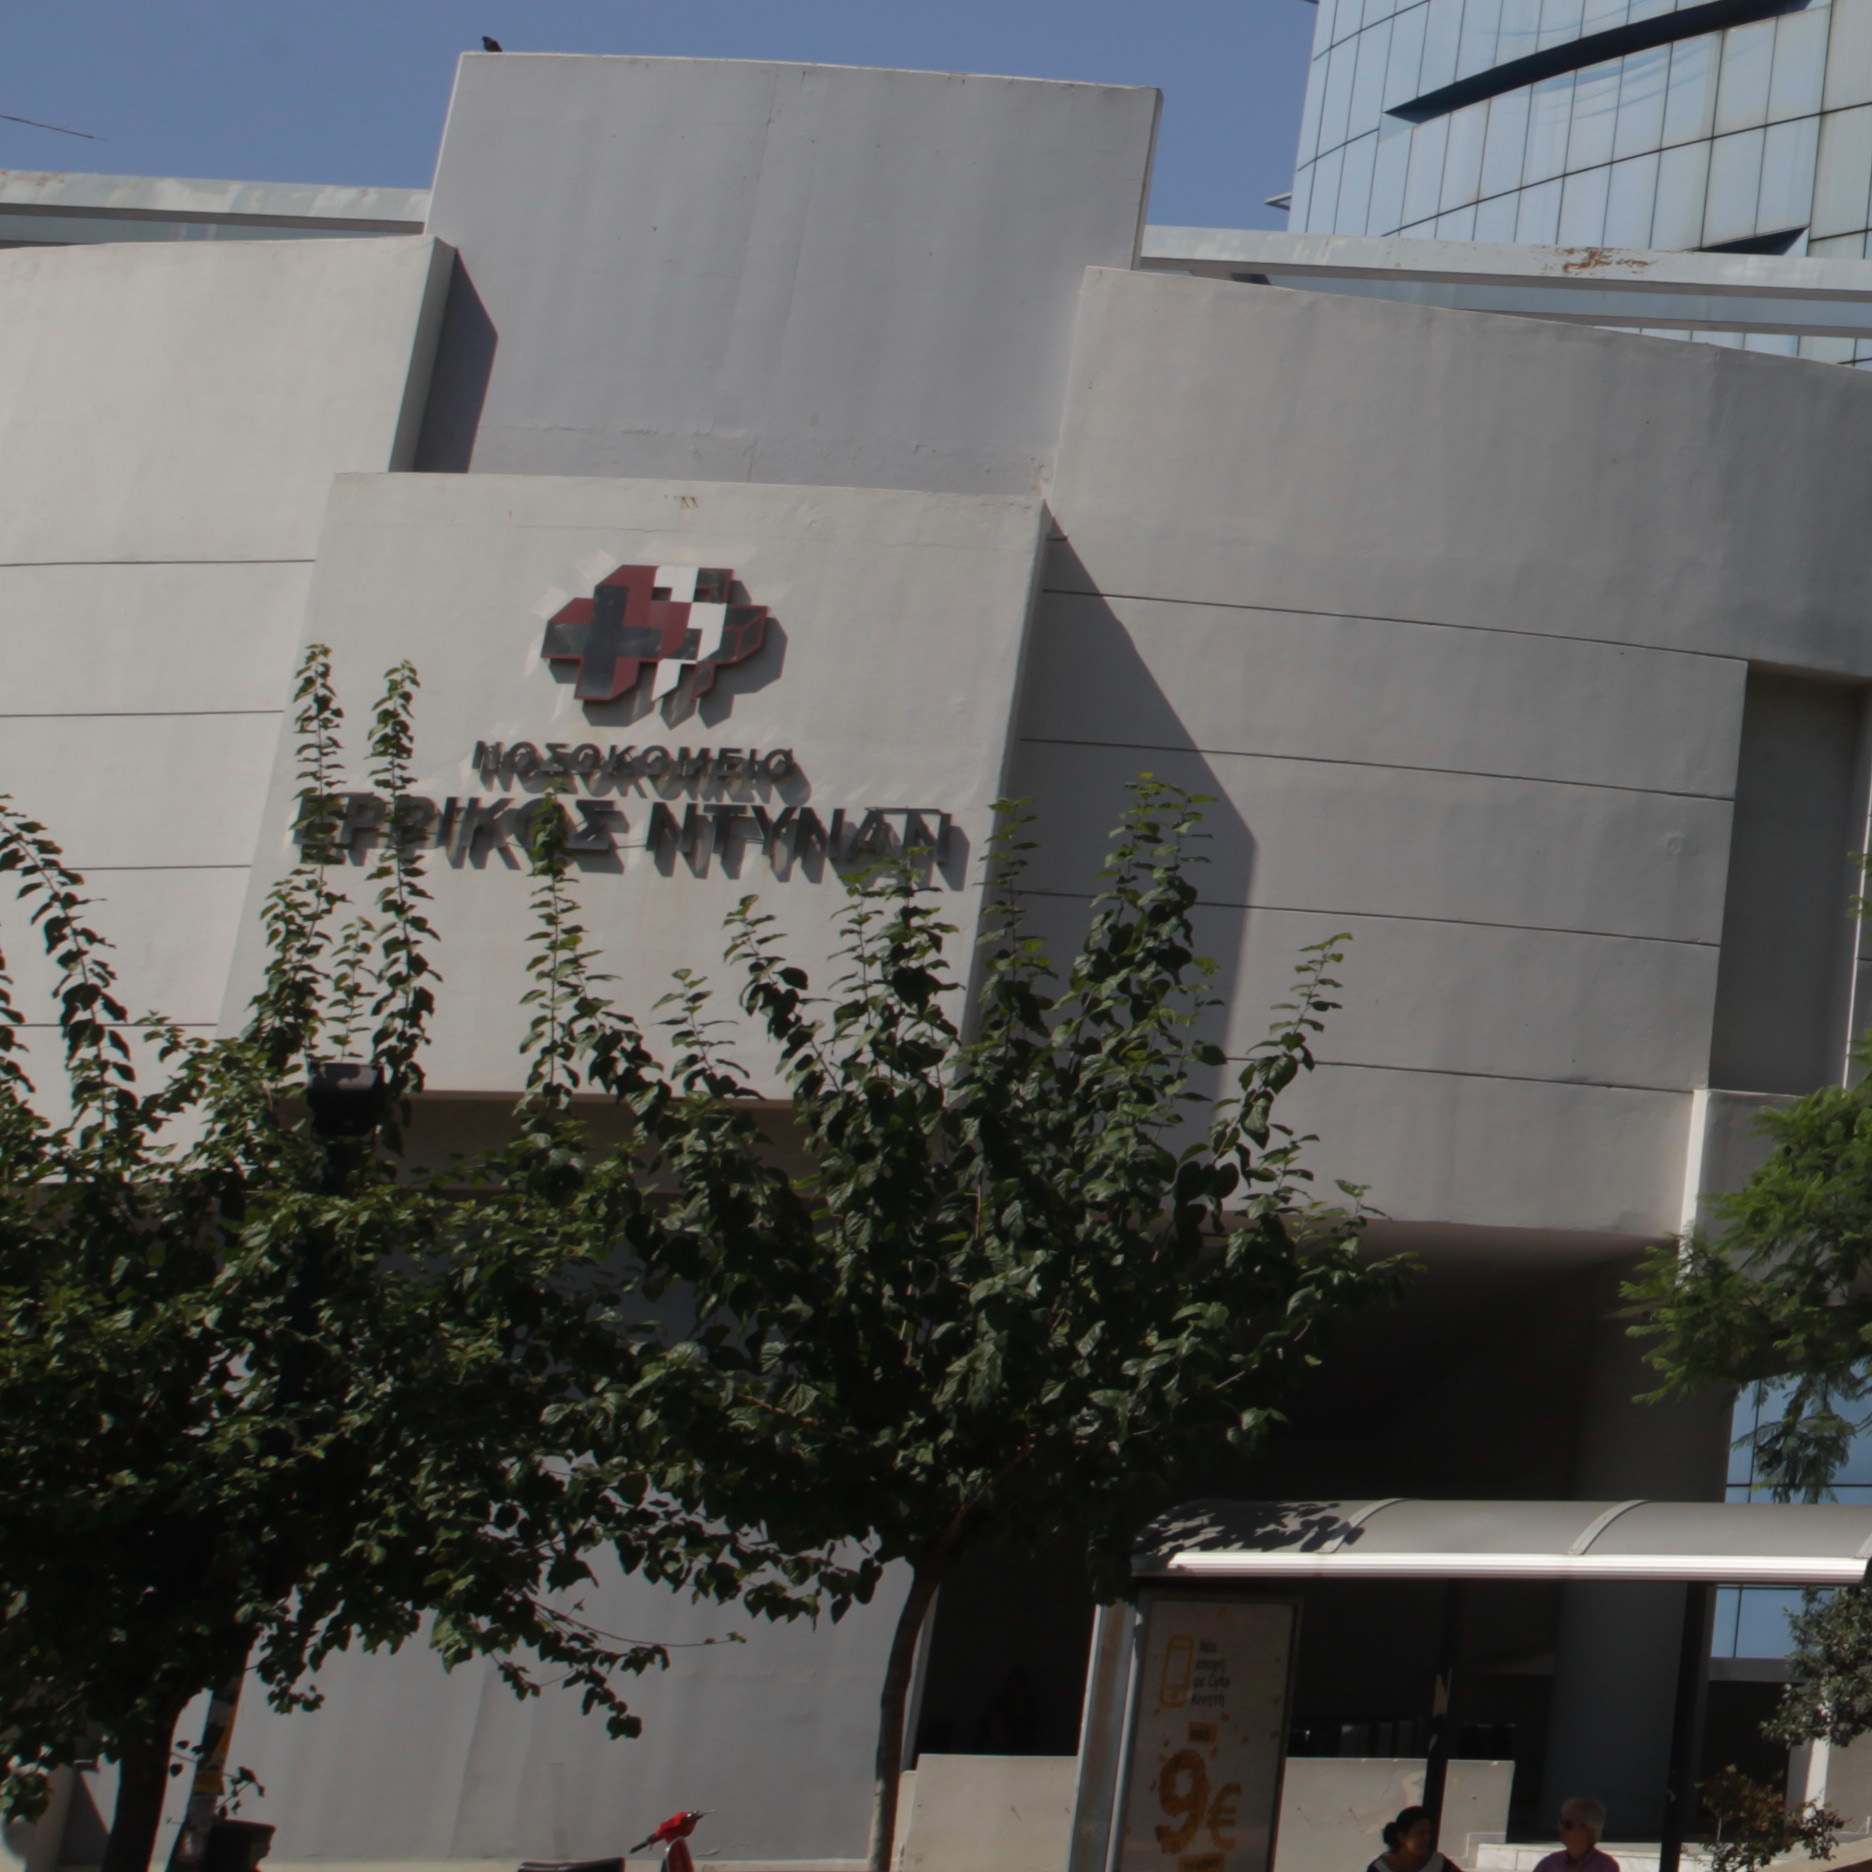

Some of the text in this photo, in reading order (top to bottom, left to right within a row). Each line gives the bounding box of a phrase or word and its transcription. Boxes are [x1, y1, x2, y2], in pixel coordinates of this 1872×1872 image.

[472, 740, 795, 777] ΝΟΣΟΚΟΜΕΙΟ
[293, 792, 953, 864] ΕΡΡΙΚΟΣ ΝΤΥΝΑΝ
